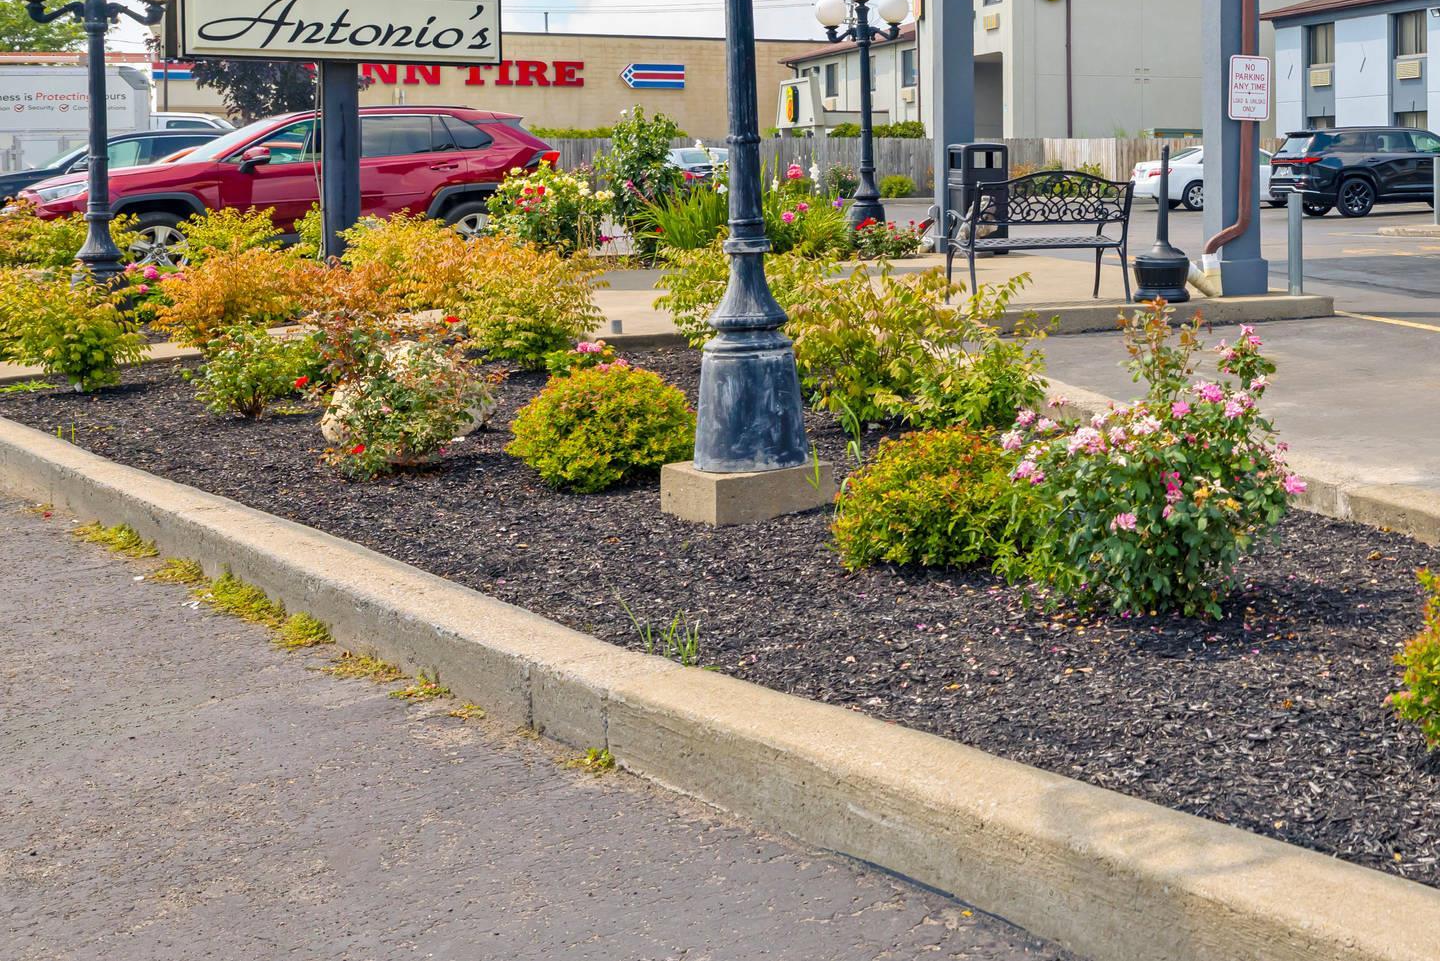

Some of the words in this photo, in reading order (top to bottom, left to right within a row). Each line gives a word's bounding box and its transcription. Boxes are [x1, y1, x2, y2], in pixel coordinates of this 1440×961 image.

[362, 63, 440, 85] NN
[457, 60, 584, 87] TIRE
[1235, 73, 1264, 81] PARKING
[1251, 83, 1266, 91] TIME
[24, 93, 33, 101] is
